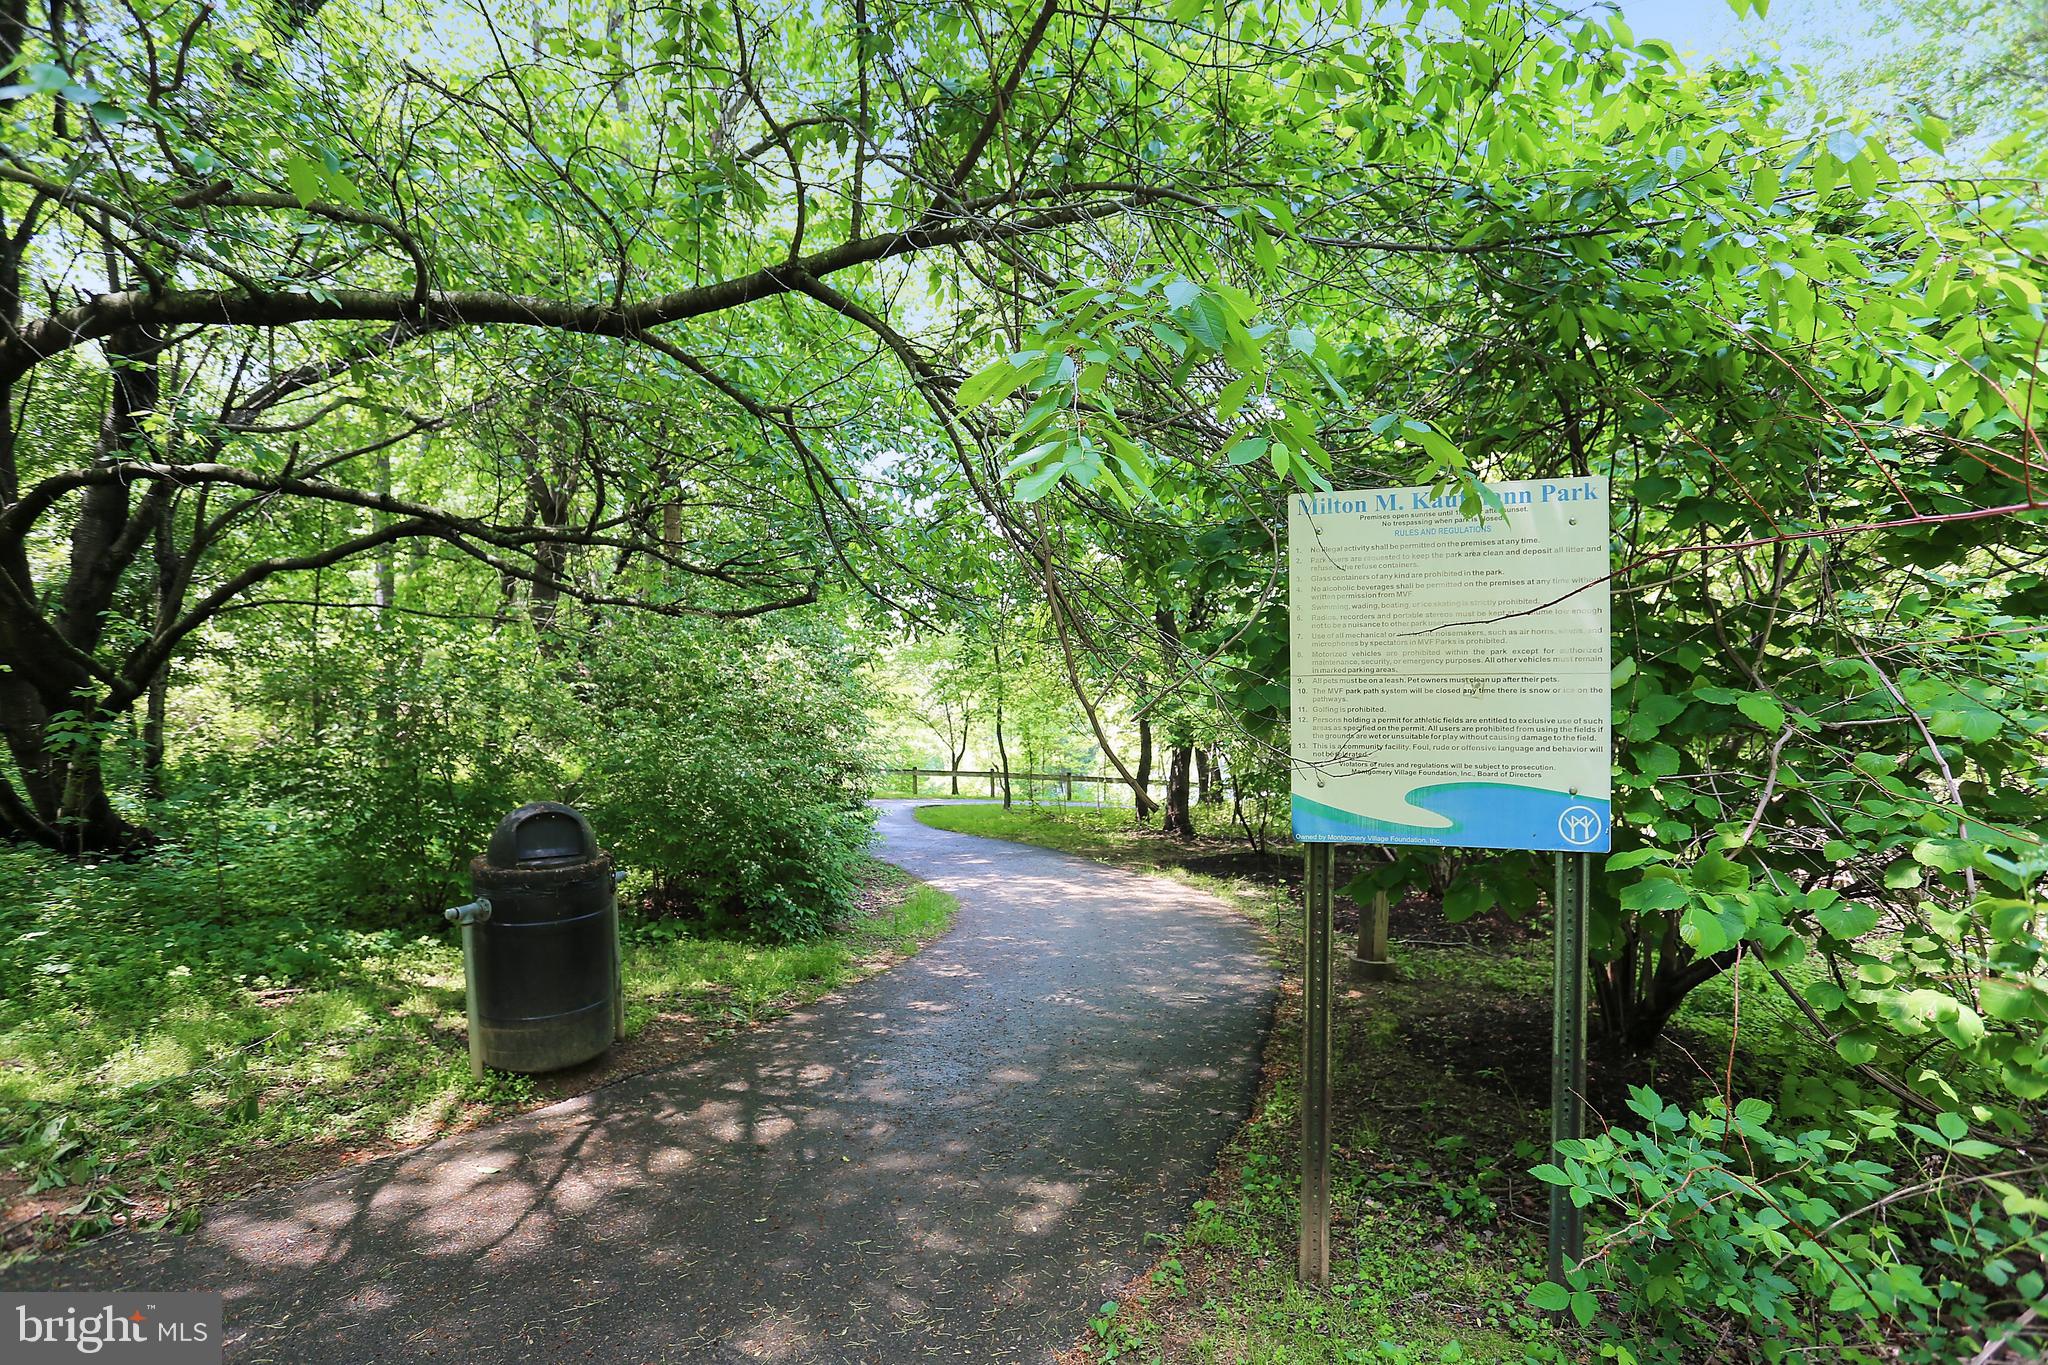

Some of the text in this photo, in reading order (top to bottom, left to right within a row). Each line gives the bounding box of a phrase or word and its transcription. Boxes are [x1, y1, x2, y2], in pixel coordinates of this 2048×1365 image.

[1298, 483, 1601, 516] Milton M. Kaunn Park
[1360, 513, 1390, 521] Premises
[1392, 512, 1409, 520] open
[1411, 509, 1436, 517] sunrise
[1393, 518, 1432, 528] trespassing
[1395, 525, 1492, 537] RULES AND REGULATIONS
[1344, 543, 1369, 553] activity
[1370, 542, 1389, 550] shall
[1400, 540, 1435, 551] permitted
[1461, 537, 1495, 548] premises
[1506, 538, 1519, 546] any
[1446, 550, 1462, 560] park
[1483, 548, 1503, 556] clean
[1505, 547, 1520, 555] and
[1523, 546, 1552, 557] deposit
[1586, 544, 1602, 552] and
[1332, 572, 1369, 581] containers
[1379, 573, 1393, 581] any
[1394, 571, 1410, 579] kind
[1424, 569, 1463, 580] prohibited
[1472, 568, 1484, 576] the
[1486, 568, 1504, 577] park.
[1322, 583, 1354, 592] alcoholic
[1357, 582, 1394, 592] beverages
[1396, 581, 1414, 589] shall
[1489, 578, 1525, 588] premises
[1337, 590, 1395, 601] permission from
[1352, 597, 1539, 611] wading, prohibited.
[1340, 611, 1375, 620] recorders
[1348, 618, 1409, 627] nuisance other
[1346, 628, 1506, 638] mechanical such
[1370, 639, 1408, 649] spectators
[1466, 636, 1508, 647] prohibited.
[1352, 649, 1382, 657] vehicles
[1473, 647, 1485, 655] the
[1491, 647, 1507, 657] park
[1512, 647, 1538, 656] except
[1361, 658, 1392, 667] security,
[1403, 659, 1444, 667] emergency
[1445, 658, 1482, 666] purposes.
[1497, 655, 1517, 663] other
[1347, 666, 1375, 675] parking
[1340, 676, 1357, 684] must
[1449, 675, 1468, 683] must
[1469, 675, 1490, 683] clean
[1491, 677, 1502, 685] up
[1541, 675, 1559, 685] pets.
[1346, 687, 1361, 696] park
[1364, 687, 1379, 696] path
[1381, 687, 1408, 696] system
[1436, 686, 1460, 694] closed
[1463, 688, 1476, 696] any
[1347, 705, 1386, 714] prohibited.
[1343, 716, 1371, 725] holding
[1378, 716, 1401, 725] permit
[1583, 716, 1603, 724] such
[1401, 724, 1425, 733] permit.
[1475, 724, 1515, 734] prohibited
[1537, 725, 1558, 734] using
[1443, 732, 1458, 742] play
[1459, 732, 1488, 740] without
[1489, 733, 1519, 743] causing
[1521, 733, 1551, 743] damage
[1385, 742, 1410, 752] facility.
[1413, 743, 1432, 751] Foul,
[1461, 743, 1497, 751] offensive
[1498, 744, 1534, 754] language
[1536, 744, 1550, 752] and
[1396, 760, 1411, 768] and
[1413, 761, 1449, 771] regulations
[1450, 761, 1462, 769] will
[1474, 762, 1500, 772] subject
[1510, 762, 1556, 772] prosecution.
[1394, 768, 1417, 777] Village
[1418, 768, 1459, 777] Foundation,
[1477, 769, 1498, 777] Board
[1509, 770, 1541, 778] Directors
[1318, 834, 1389, 843] by Montgomery Village
